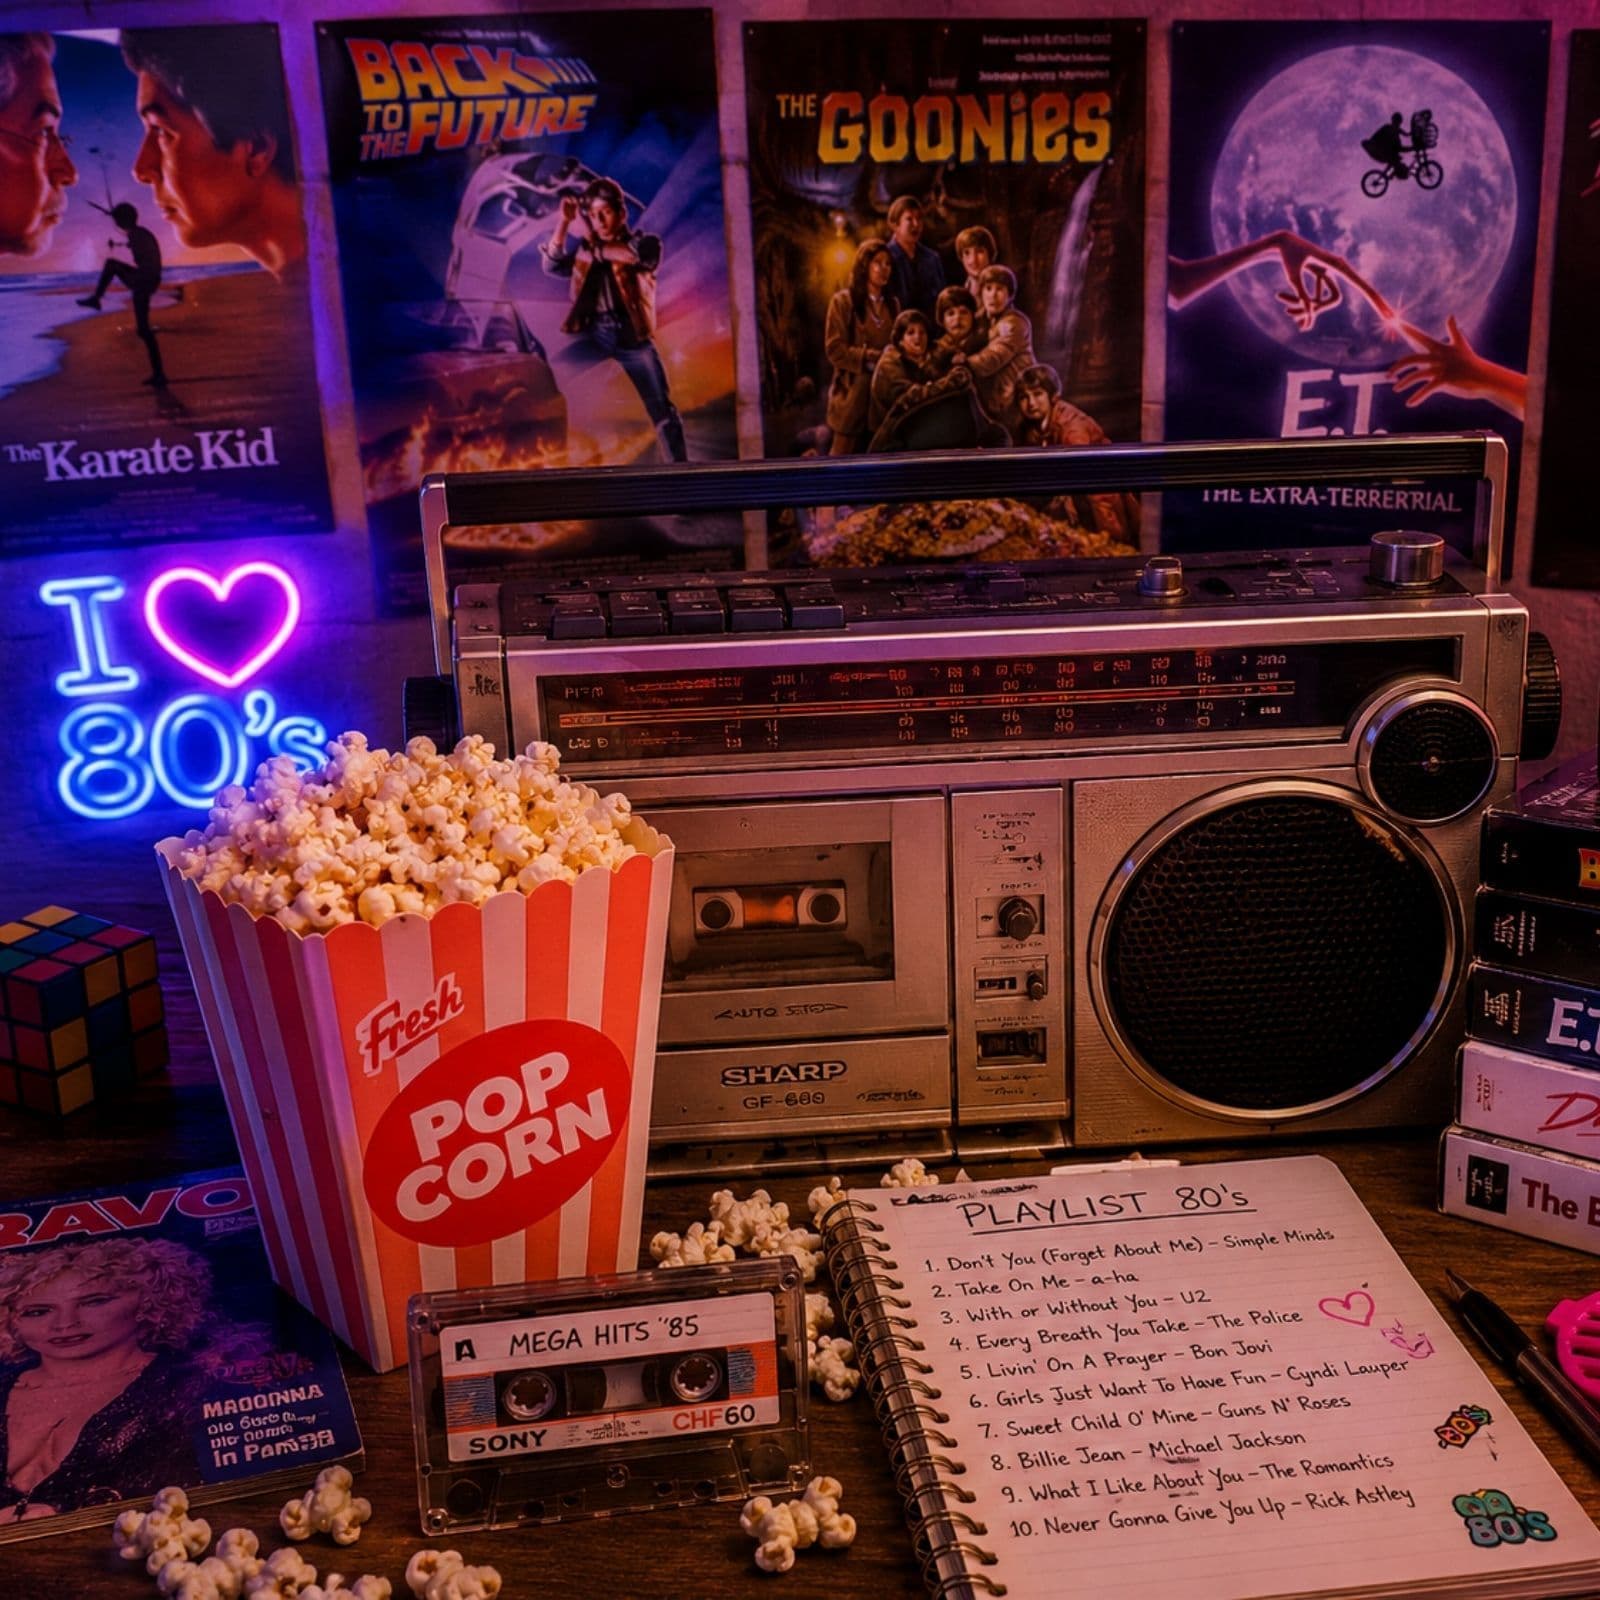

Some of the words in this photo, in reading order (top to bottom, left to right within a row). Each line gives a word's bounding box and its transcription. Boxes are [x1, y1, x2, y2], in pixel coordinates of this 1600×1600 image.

[345, 38, 553, 100] BACK
[362, 103, 404, 131] TO
[404, 95, 598, 155] FUTURE
[777, 94, 817, 118] THE
[359, 131, 407, 161] THE
[1280, 369, 1393, 438] E.T.
[2, 444, 43, 463] The
[37, 440, 195, 482] Karate
[193, 426, 280, 471] Kid
[38, 574, 140, 697] I
[57, 689, 328, 819] 80's
[355, 971, 464, 1078] Fresh
[721, 1060, 847, 1088] SHARP
[409, 1051, 570, 1163] POP
[396, 1087, 612, 1223] CORN
[956, 1191, 1147, 1228] PLAYLIST
[1175, 1183, 1249, 1211] 80's
[1521, 1177, 1579, 1220] The
[925, 1259, 940, 1273] 1.
[947, 1254, 995, 1271] Don't
[1002, 1252, 1036, 1271] You
[1041, 1246, 1107, 1266] (Forget
[1113, 1243, 1163, 1257] About
[1168, 1236, 1204, 1253] Me)
[1223, 1232, 1280, 1251] Simple
[1283, 1227, 1335, 1243] Minds
[931, 1284, 952, 1299] 2.
[955, 1281, 1001, 1296] Take
[1008, 1278, 1034, 1294] On
[1042, 1275, 1070, 1290] Me
[1091, 1269, 1139, 1285] a-ha
[940, 1310, 960, 1325] 3.
[966, 1307, 1012, 1323] With
[1020, 1306, 1039, 1318] or
[1046, 1296, 1118, 1314] Without
[1124, 1293, 1158, 1313] You
[1180, 1289, 1212, 1304] U2
[454, 1337, 477, 1361] A
[509, 1330, 583, 1356] MEGA
[594, 1321, 650, 1346] HITS
[949, 1335, 970, 1351] 4.
[976, 1334, 1032, 1353] Every
[1037, 1325, 1102, 1343] Breath
[1106, 1323, 1140, 1343] You
[1142, 1317, 1190, 1335] Take
[1207, 1313, 1245, 1329] The
[1247, 1309, 1304, 1324] Police
[960, 1364, 981, 1380] 5.
[987, 1359, 1037, 1378] Livin'
[1046, 1356, 1074, 1373] On
[1082, 1354, 1097, 1368] A
[1104, 1351, 1168, 1371] Prayer
[1190, 1344, 1229, 1360] Bon
[1232, 1339, 1274, 1356] Jovi
[969, 1393, 989, 1409] 6.
[996, 1388, 1045, 1408] Girls
[1050, 1384, 1093, 1406] Just
[1098, 1378, 1148, 1398] Want
[1151, 1376, 1176, 1393] To
[1182, 1375, 1227, 1391] Have
[1231, 1369, 1267, 1385] Fun
[1286, 1362, 1340, 1387] Cyndi
[1343, 1360, 1410, 1379] Lauper
[977, 1422, 999, 1439] 7.
[1006, 1416, 1063, 1437] Sweet
[1070, 1412, 1122, 1432] Child
[1127, 1410, 1145, 1427] O'
[1151, 1408, 1199, 1425] Mine
[1217, 1402, 1267, 1419] Guns
[1271, 1397, 1291, 1413] N'
[1297, 1396, 1352, 1411] Roses
[468, 1429, 548, 1455] SONY
[990, 1454, 1012, 1471] 8.
[1017, 1451, 1071, 1470] Billie
[1075, 1446, 1126, 1464] Jean
[1148, 1435, 1223, 1458] Michael
[1228, 1430, 1307, 1451] Jackson
[1001, 1486, 1023, 1503] 9.
[1029, 1480, 1082, 1502] What
[1086, 1478, 1099, 1497] I
[1103, 1475, 1147, 1495] Like
[1152, 1469, 1205, 1491] About
[1208, 1466, 1245, 1491] You
[1259, 1462, 1298, 1480] The
[1299, 1454, 1395, 1476] Romantics
[1010, 1518, 1040, 1538] 10.
[1043, 1515, 1101, 1535] Never
[1108, 1509, 1169, 1529] Gonna
[1174, 1503, 1218, 1523] Give
[1220, 1499, 1255, 1525] You
[1257, 1496, 1287, 1521] Up
[1304, 1492, 1352, 1510] Rick
[1355, 1483, 1416, 1508] Astley
